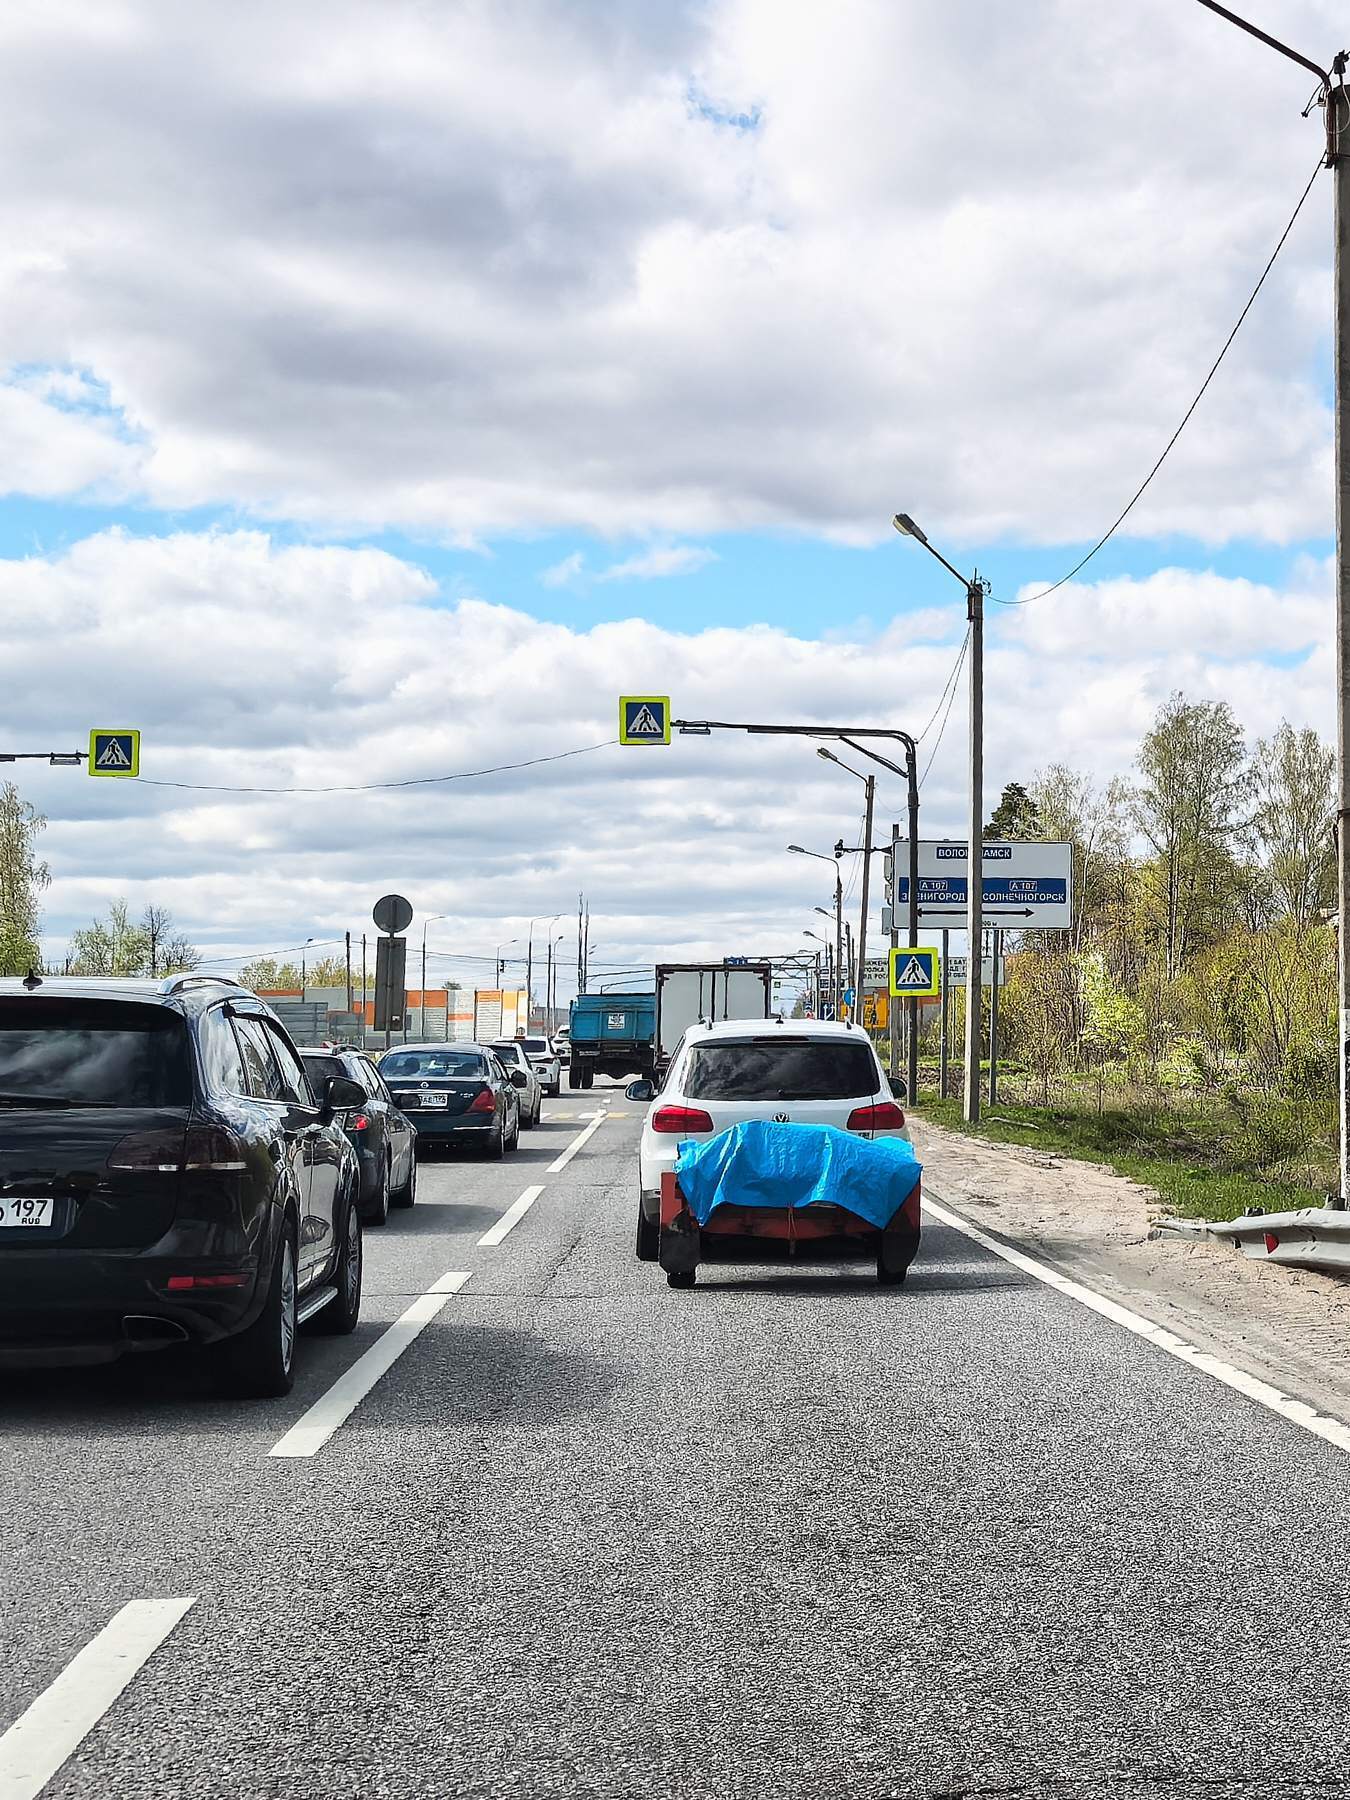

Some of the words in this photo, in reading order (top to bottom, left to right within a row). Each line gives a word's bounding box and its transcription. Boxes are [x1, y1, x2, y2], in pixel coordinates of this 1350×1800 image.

[938, 848, 1010, 858] ВОЛОАМСК
[982, 893, 1065, 902] СОЛНЕЧНОГОРСК
[10, 1200, 48, 1217] 197
[21, 1217, 41, 1225] RUS
